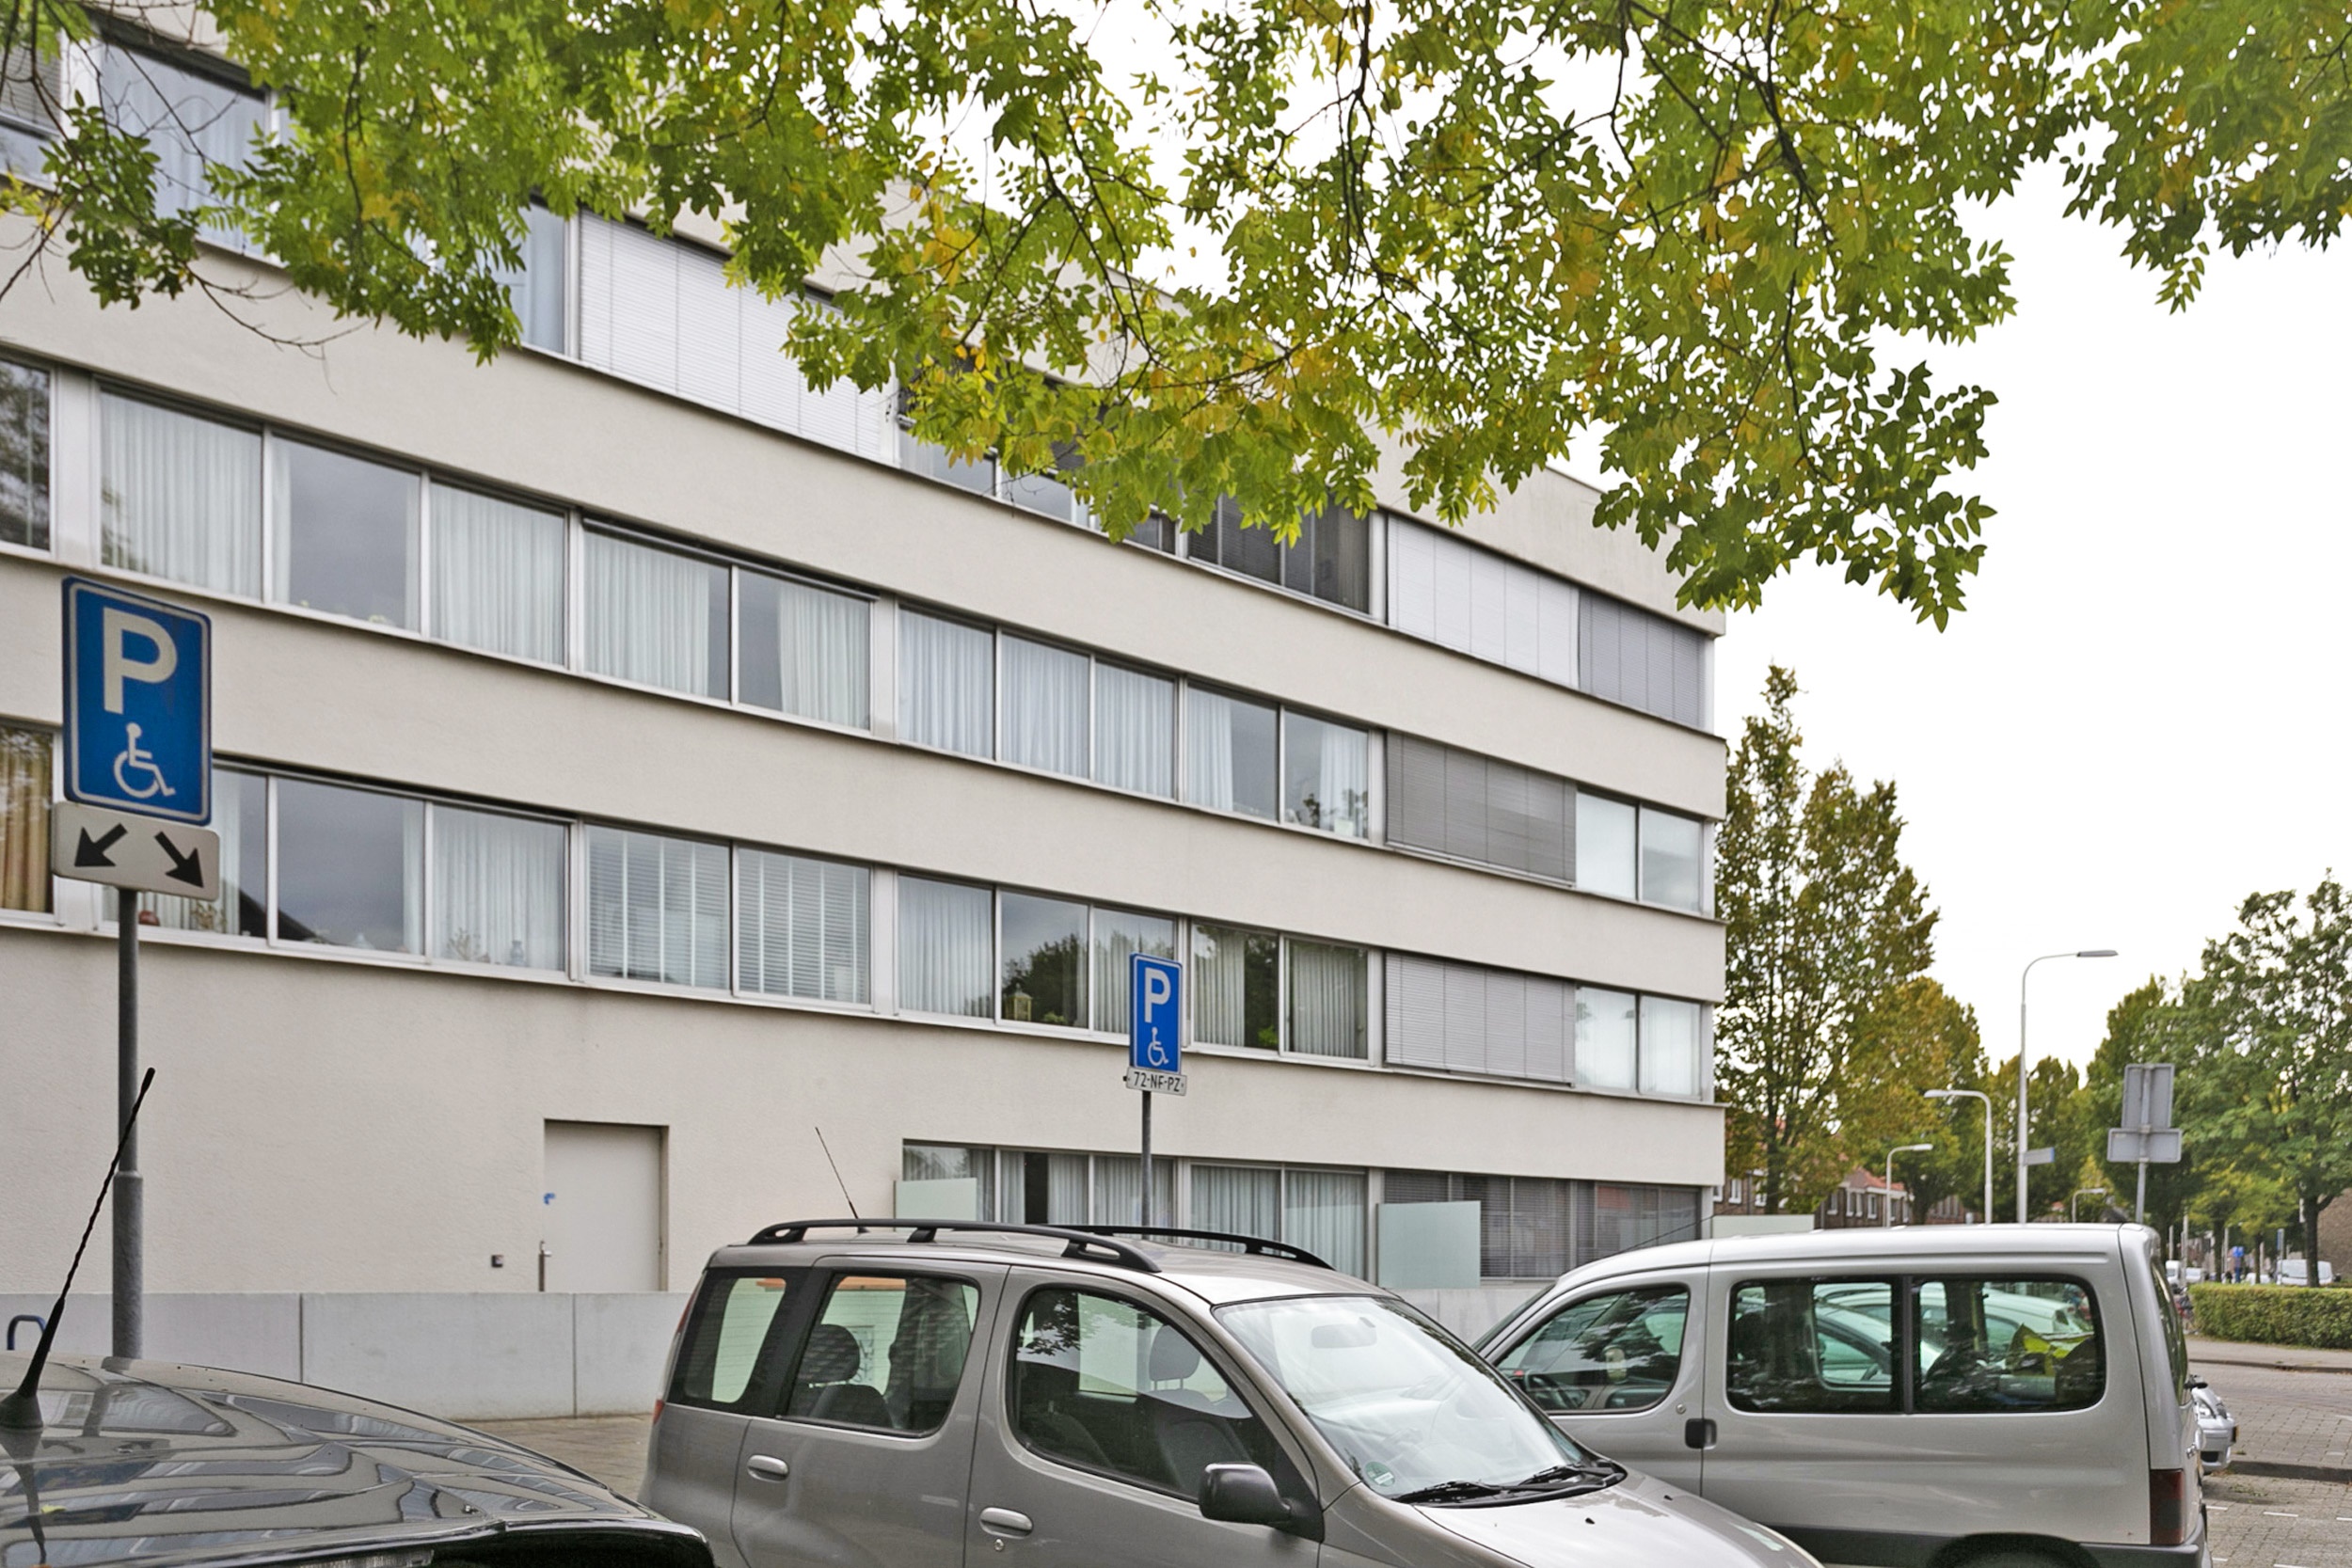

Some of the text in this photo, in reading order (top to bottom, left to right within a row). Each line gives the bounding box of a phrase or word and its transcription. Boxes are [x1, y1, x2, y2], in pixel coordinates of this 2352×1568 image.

[103, 607, 178, 715] P
[1144, 967, 1171, 1023] P
[1134, 1071, 1181, 1092] 72-NF-PZ
